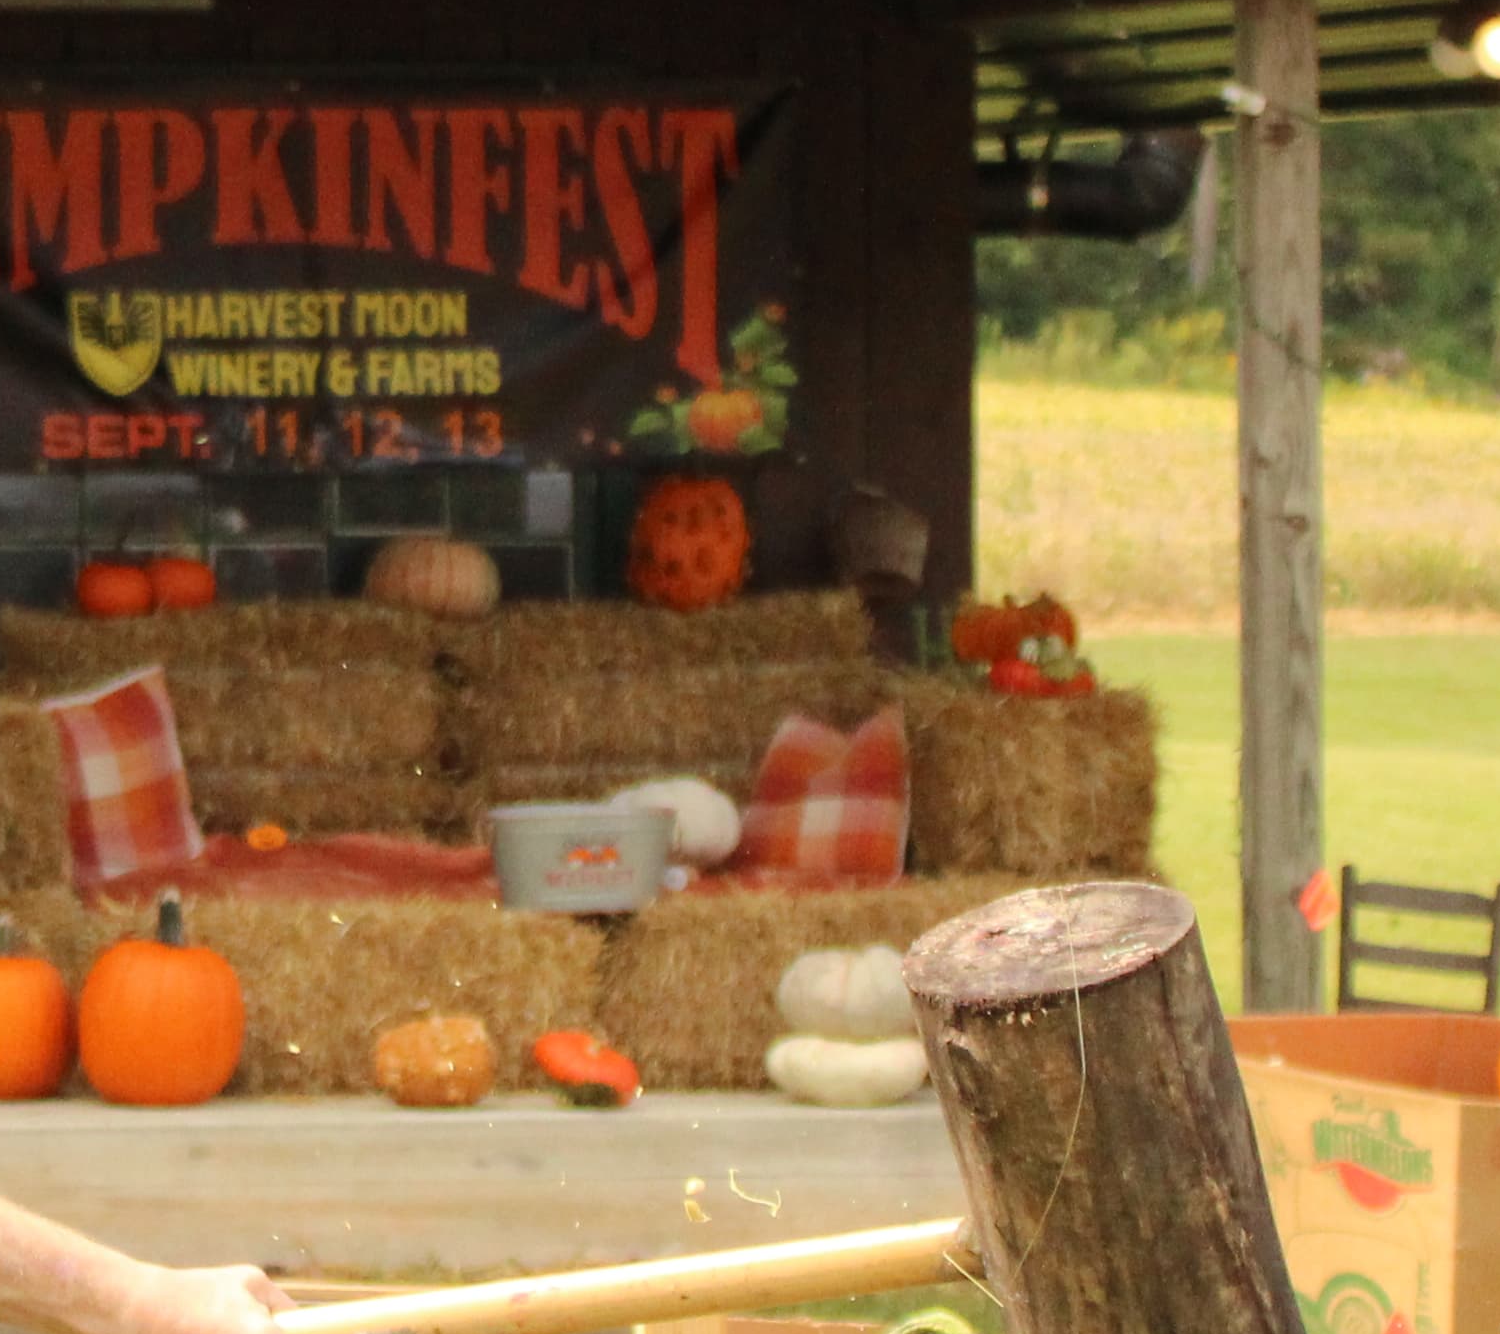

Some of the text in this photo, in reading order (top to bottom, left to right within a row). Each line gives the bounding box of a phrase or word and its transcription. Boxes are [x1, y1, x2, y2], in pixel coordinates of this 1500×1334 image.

[166, 291, 468, 338] HARVEST MOON
[169, 348, 503, 396] WINERY & FARMS
[442, 410, 504, 459] 13
